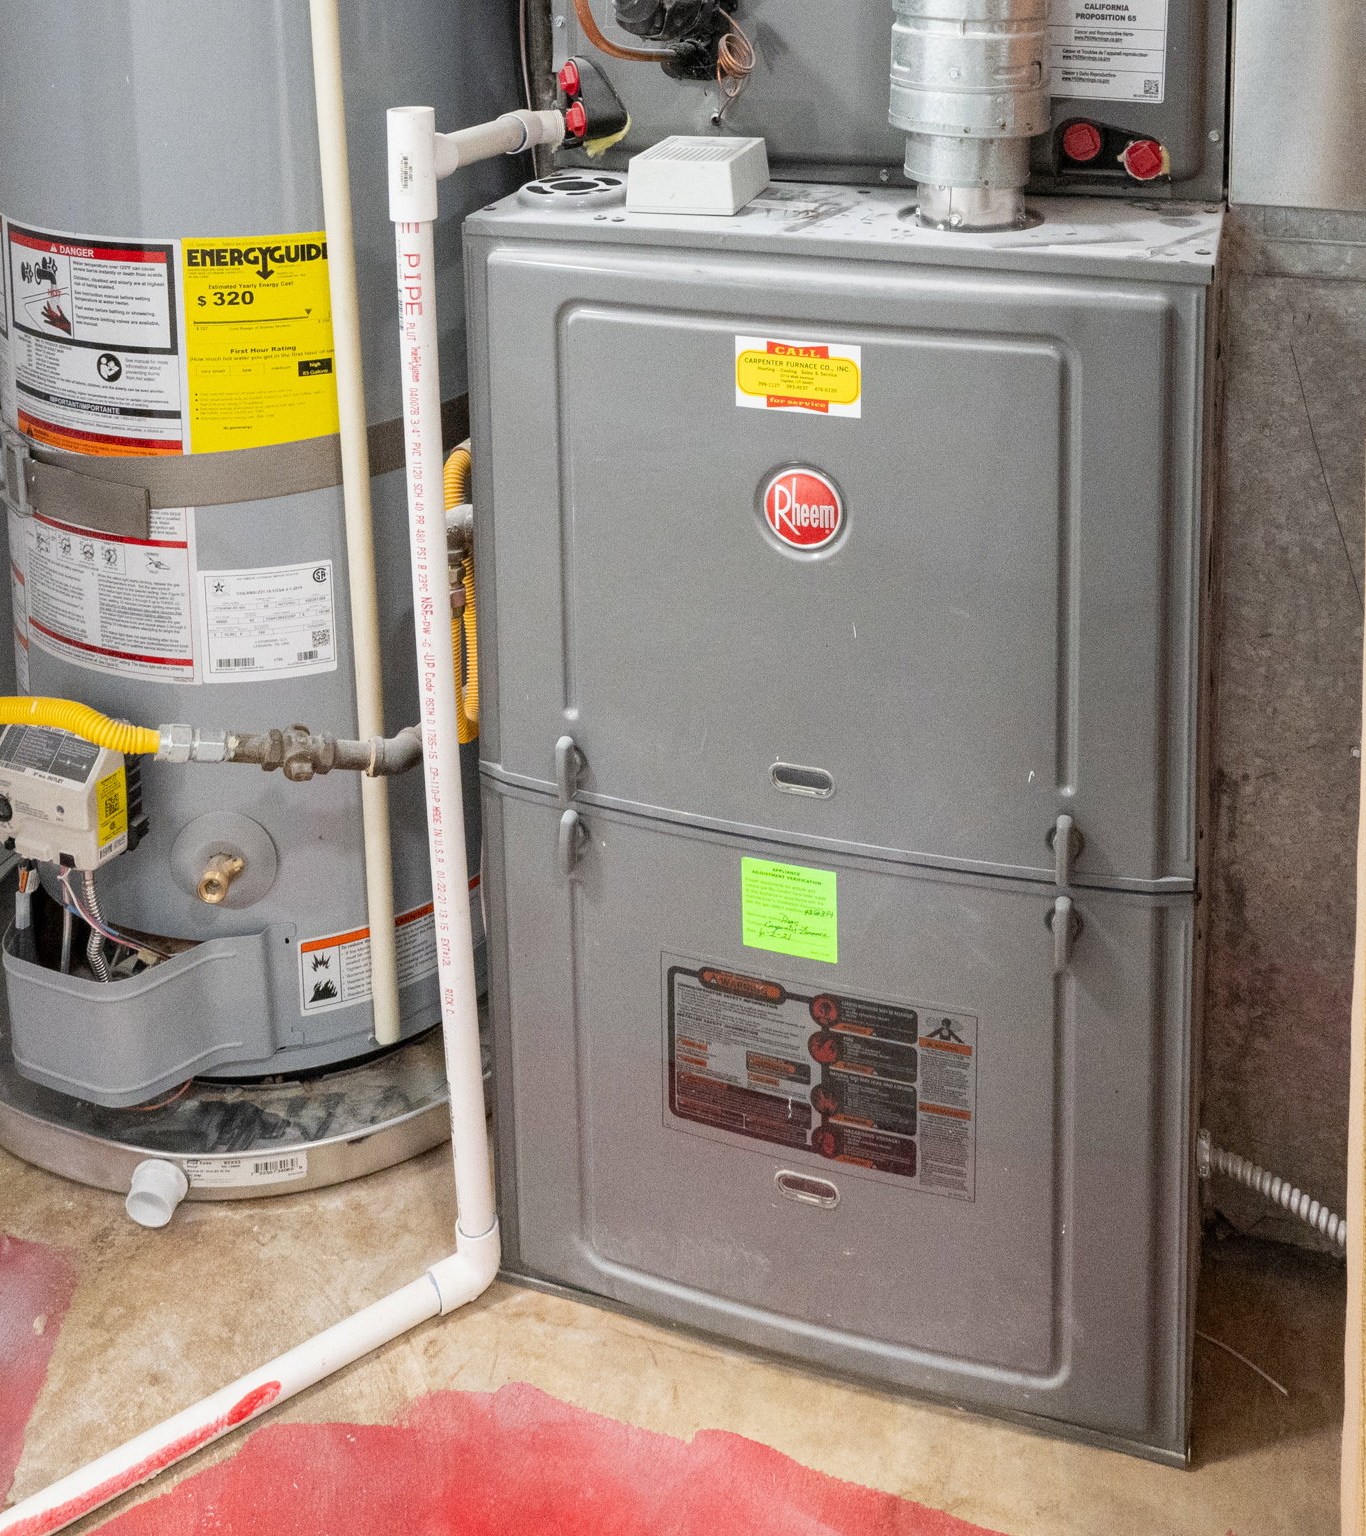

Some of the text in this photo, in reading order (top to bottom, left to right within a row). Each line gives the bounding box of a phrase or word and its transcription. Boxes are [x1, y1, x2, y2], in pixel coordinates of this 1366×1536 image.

[1084, 3, 1129, 11] CALIFORNIA
[1075, 13, 1126, 21] PROPOSITION
[59, 246, 94, 258] DANGER
[403, 253, 423, 316] PIPE
[197, 291, 254, 307] $ 320
[775, 346, 820, 358] CALL
[744, 357, 784, 366] CARPENTER
[786, 360, 817, 370] FURNACE
[49, 396, 120, 415] IMPORTANT/IMPORTANTE
[787, 399, 826, 408] service
[412, 442, 422, 456] PVC
[413, 462, 422, 479] 1120
[414, 483, 423, 498] SCH
[775, 477, 835, 536] Rheem
[415, 515, 425, 525] PR
[417, 546, 426, 560] PSI
[752, 869, 822, 886] ADJUSTMENT VERIFICATION
[772, 868, 801, 876] APPLIANCE
